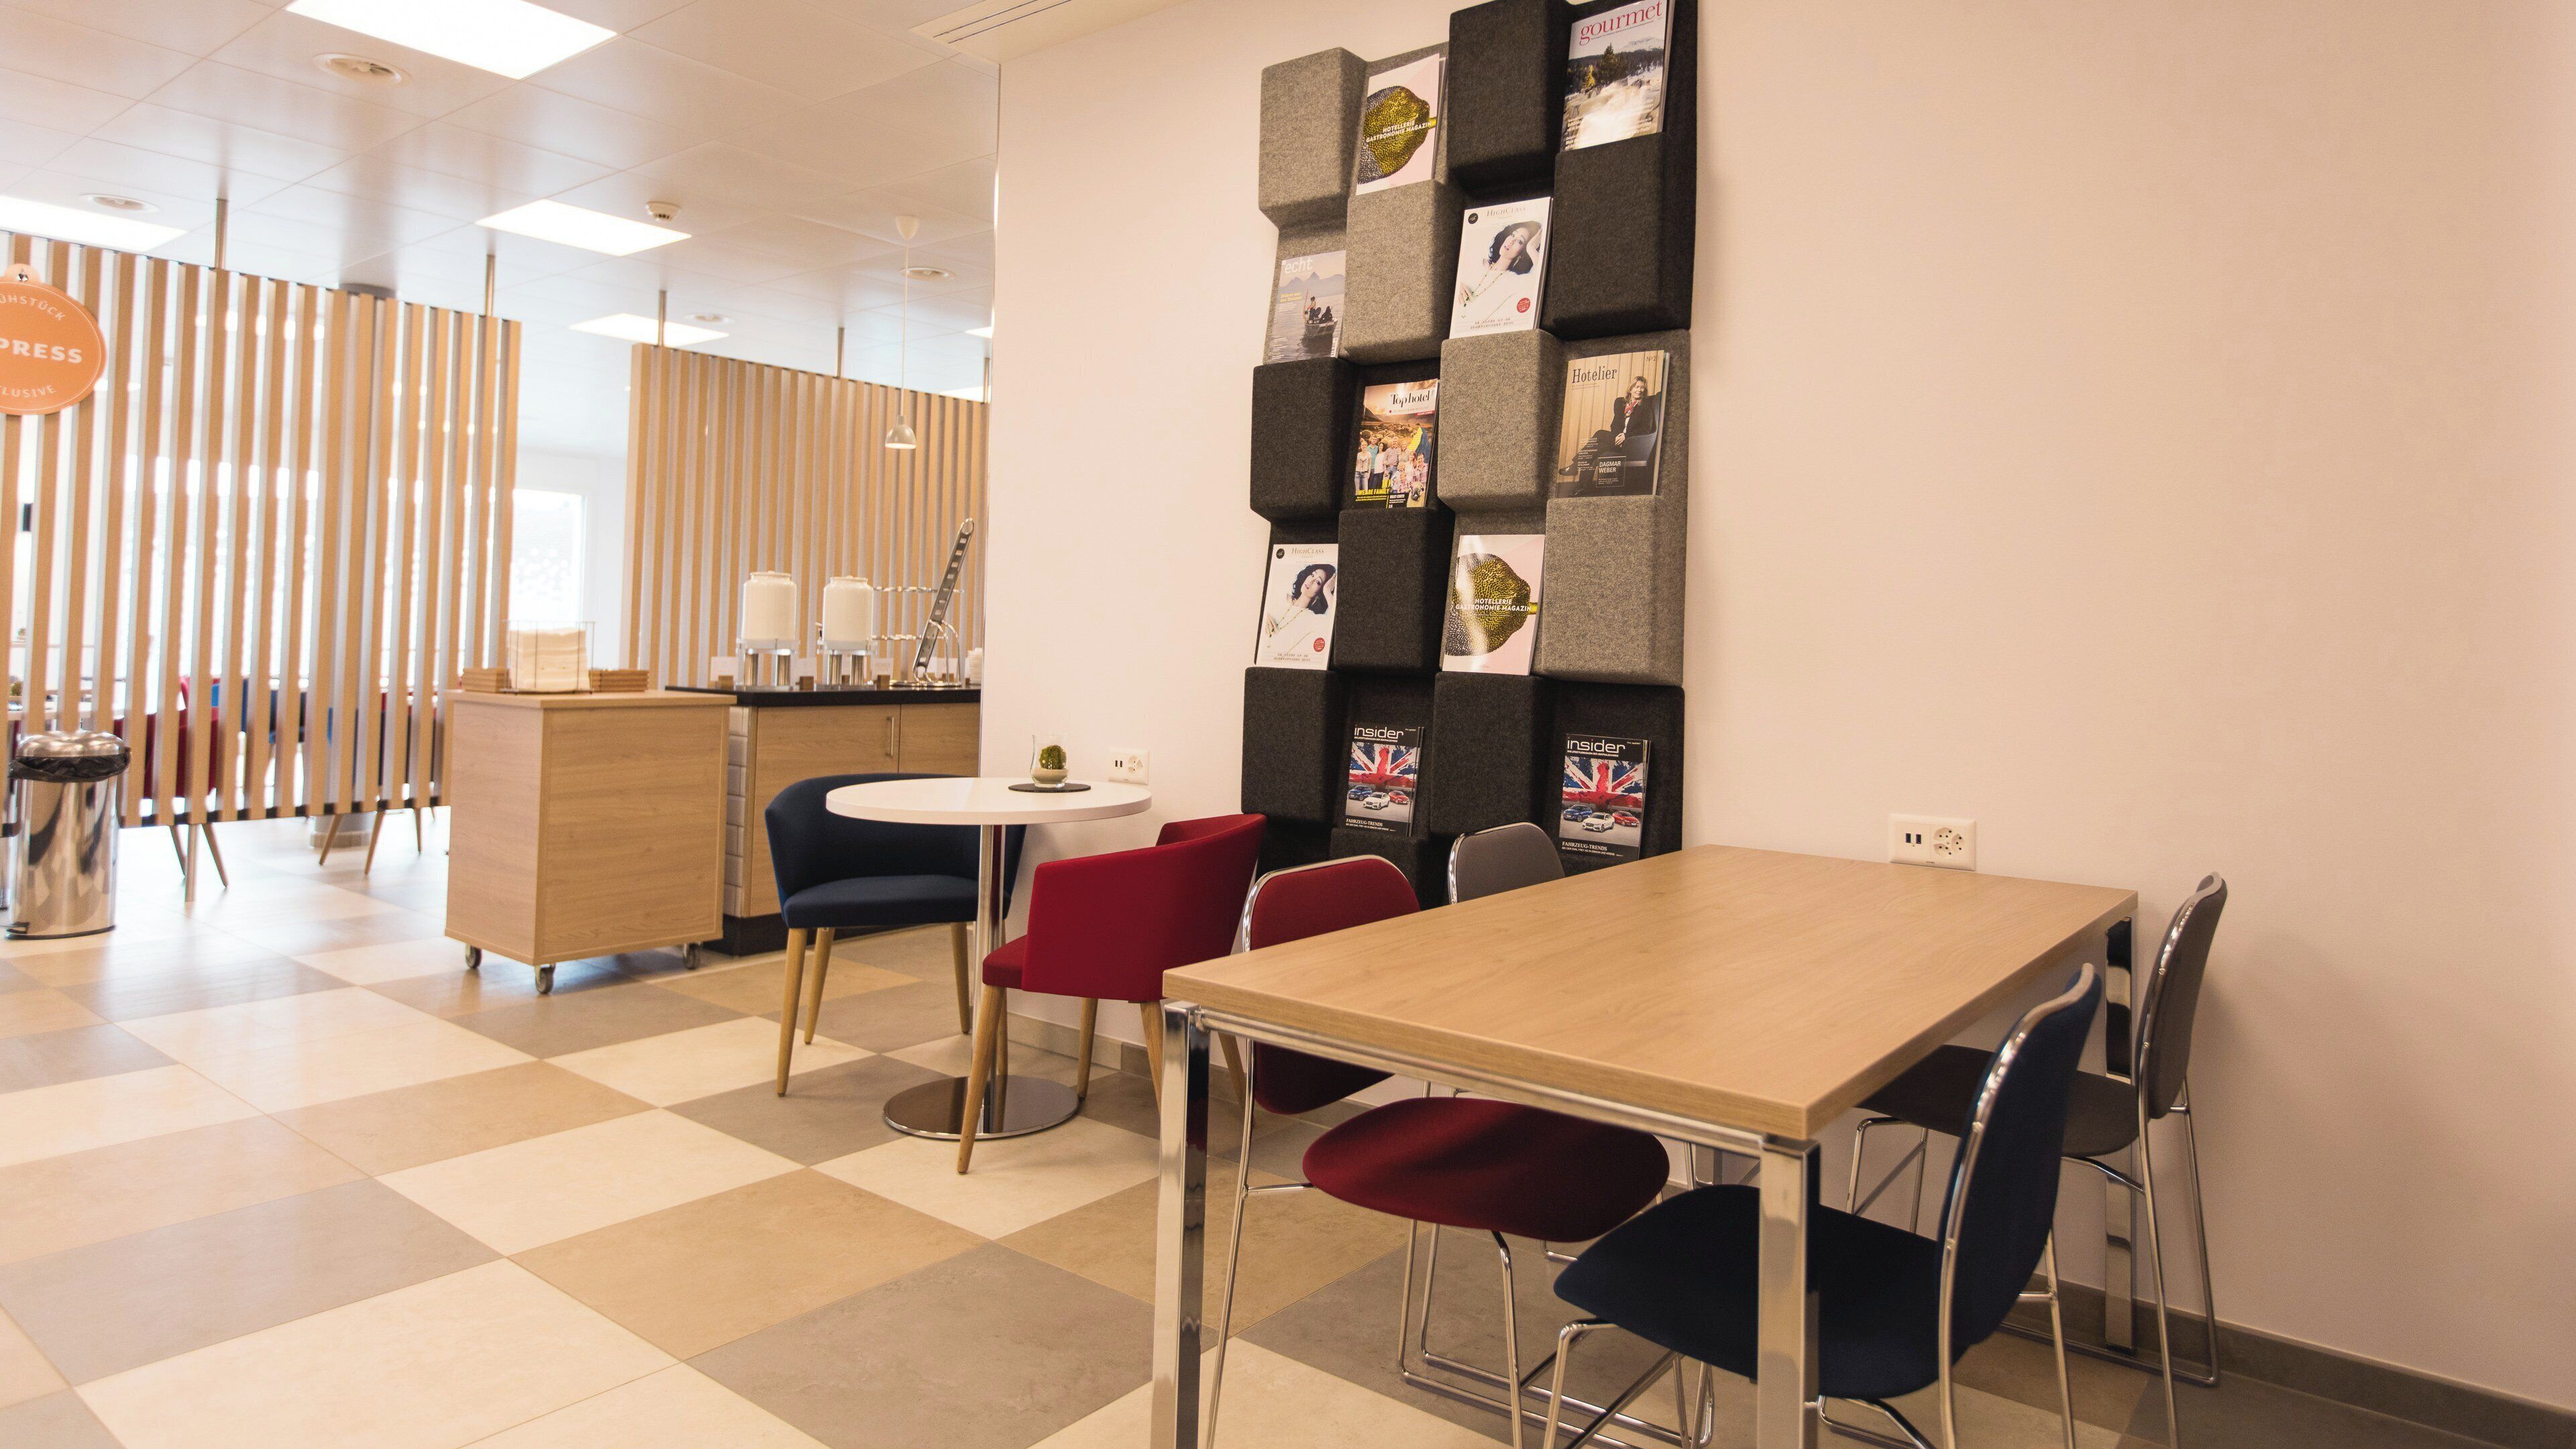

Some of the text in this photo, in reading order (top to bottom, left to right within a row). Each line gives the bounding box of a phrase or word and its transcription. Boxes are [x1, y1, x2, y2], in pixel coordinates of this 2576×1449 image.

[1579, 1, 1662, 46] gourmet
[1366, 128, 1405, 142] GASTRONOMIE
[1406, 121, 1432, 132] MAGAZIN
[1383, 120, 1415, 133] HOTELLERIE
[1285, 256, 1313, 274] echt
[1572, 366, 1617, 383] Hotelier
[0, 385, 56, 398] LUSIVE
[1354, 725, 1404, 739] insider
[1567, 737, 1625, 753] insider
[1346, 818, 1383, 826] FAHRZEUG-TRENDS
[1562, 841, 1607, 851] FAHRZEUG-TRENDS
